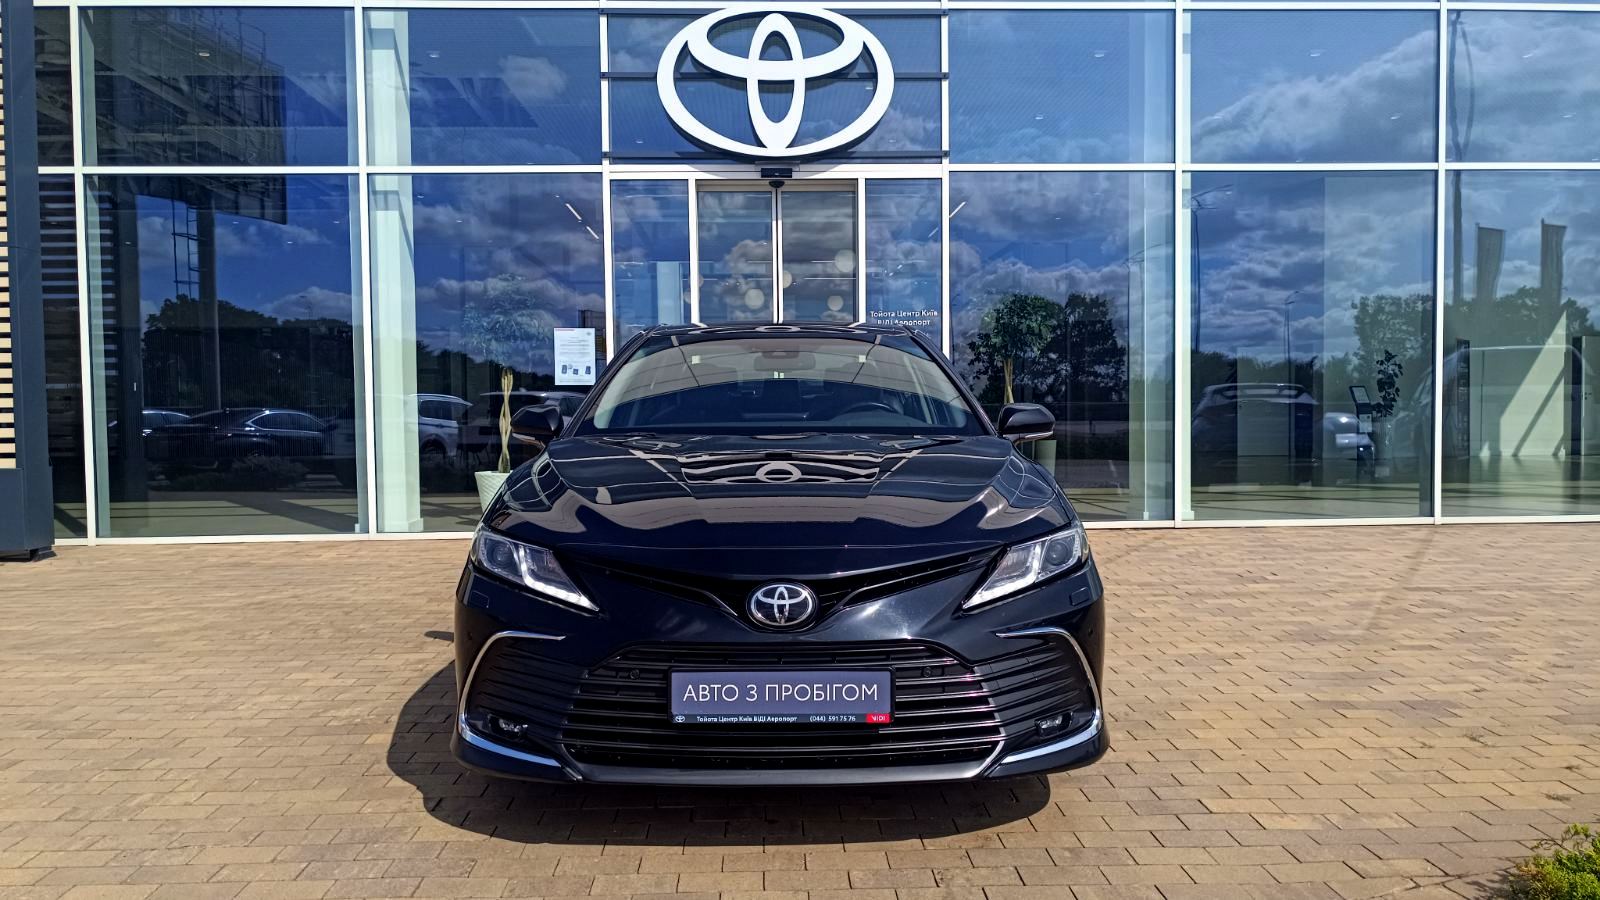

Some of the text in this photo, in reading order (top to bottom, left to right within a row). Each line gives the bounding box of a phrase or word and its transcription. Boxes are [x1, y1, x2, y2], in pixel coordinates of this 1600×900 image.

[870, 309, 938, 318] Тойота Центр Київ
[682, 684, 739, 702] АВТО
[765, 684, 878, 702] ПРОБІГОМ
[697, 715, 718, 723] Тойота
[718, 715, 739, 724] Центр
[766, 715, 798, 723] Аеропорт
[809, 715, 826, 723] (044)
